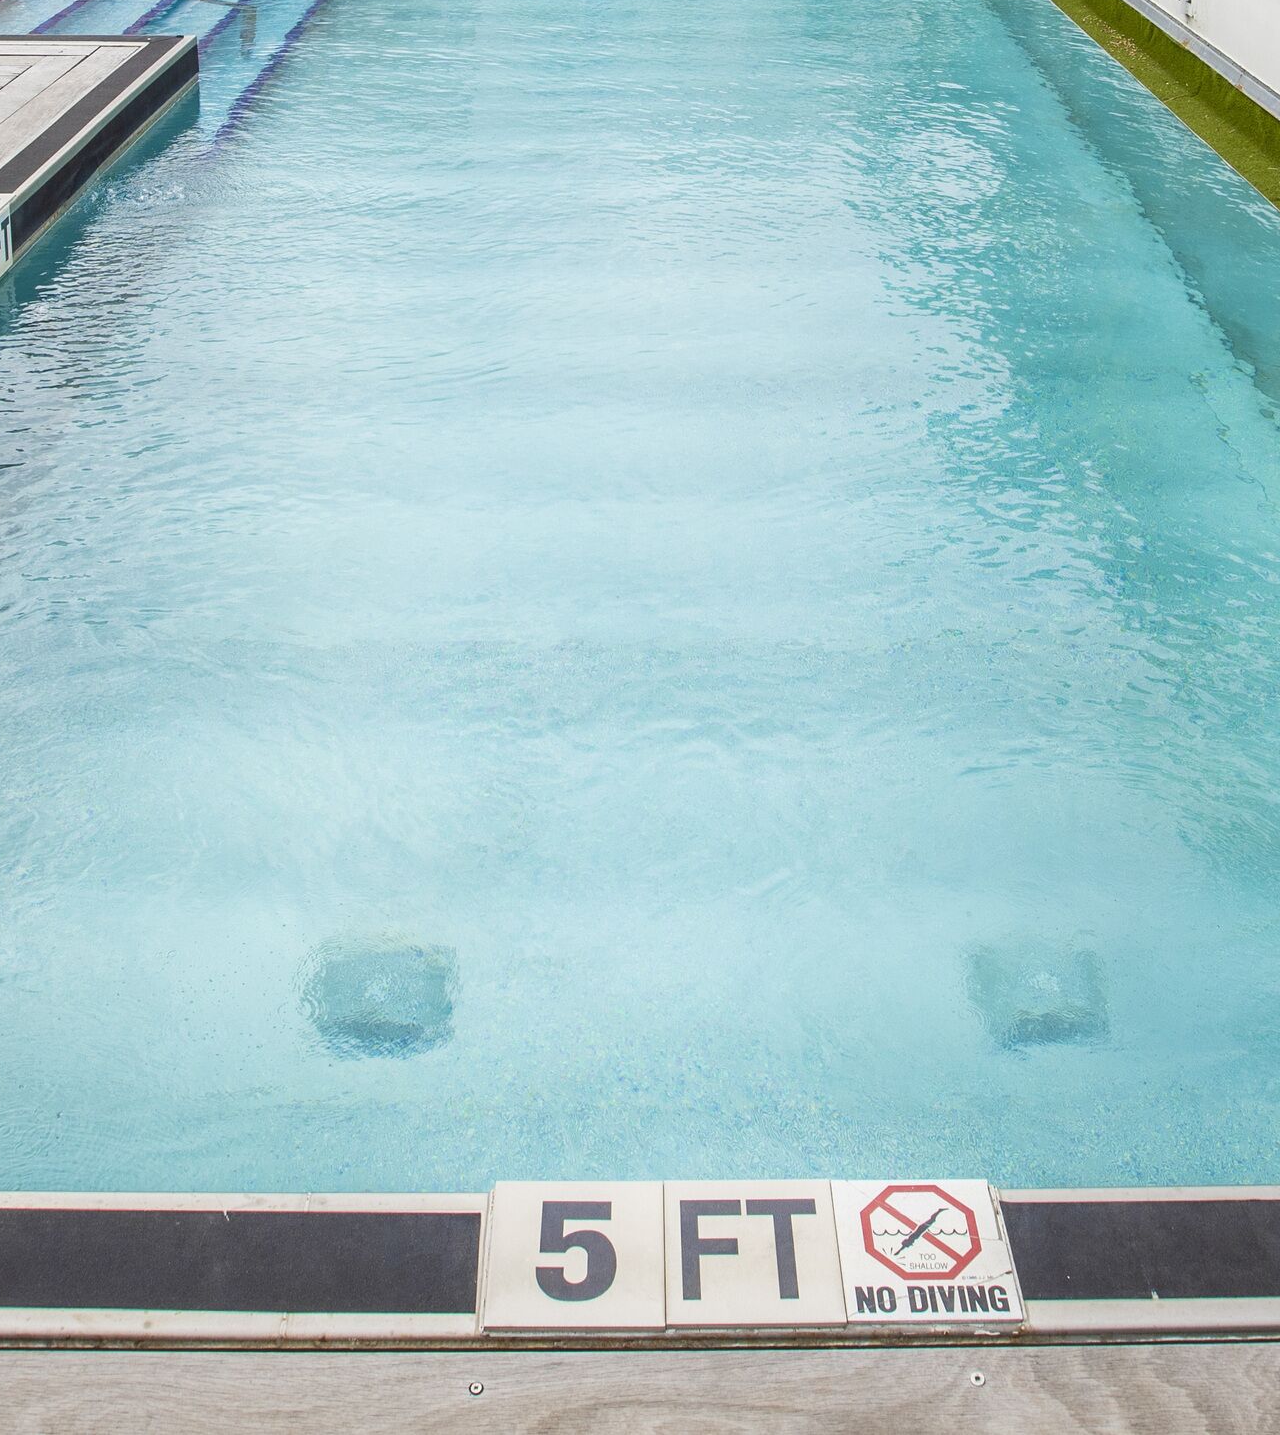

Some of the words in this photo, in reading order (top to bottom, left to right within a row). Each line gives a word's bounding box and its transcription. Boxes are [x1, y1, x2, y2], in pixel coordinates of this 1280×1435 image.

[535, 1200, 617, 1302] 5
[680, 1198, 817, 1301] FT
[919, 1253, 937, 1261] TOO
[909, 1262, 949, 1270] SHALLOW
[854, 1286, 897, 1314] NO
[907, 1285, 1011, 1313] DIVING
